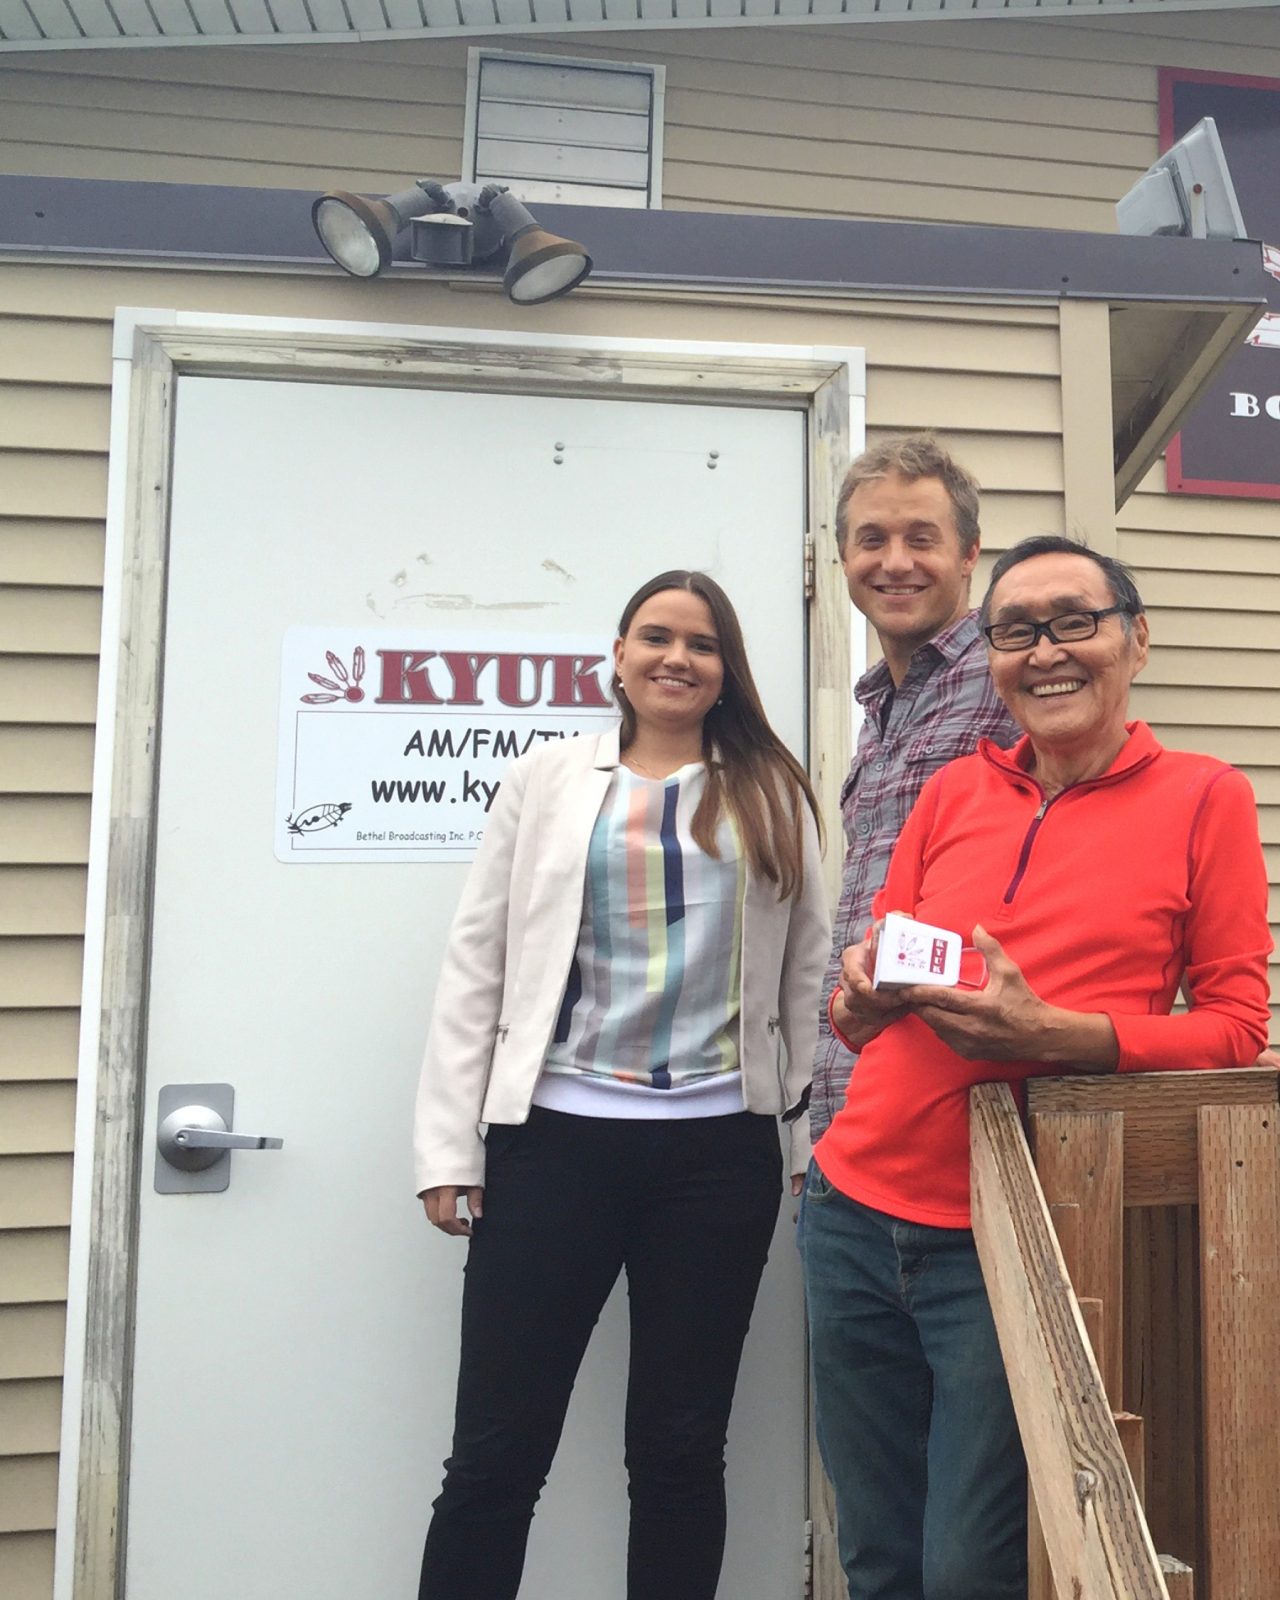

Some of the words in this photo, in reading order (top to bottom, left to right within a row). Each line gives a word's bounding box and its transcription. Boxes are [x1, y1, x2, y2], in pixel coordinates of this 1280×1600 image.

[375, 649, 614, 708] KYUK
[371, 769, 501, 813] www.ky
[356, 831, 386, 841] Bethel
[388, 831, 447, 843] Broadcasting
[932, 939, 945, 973] KYUK
